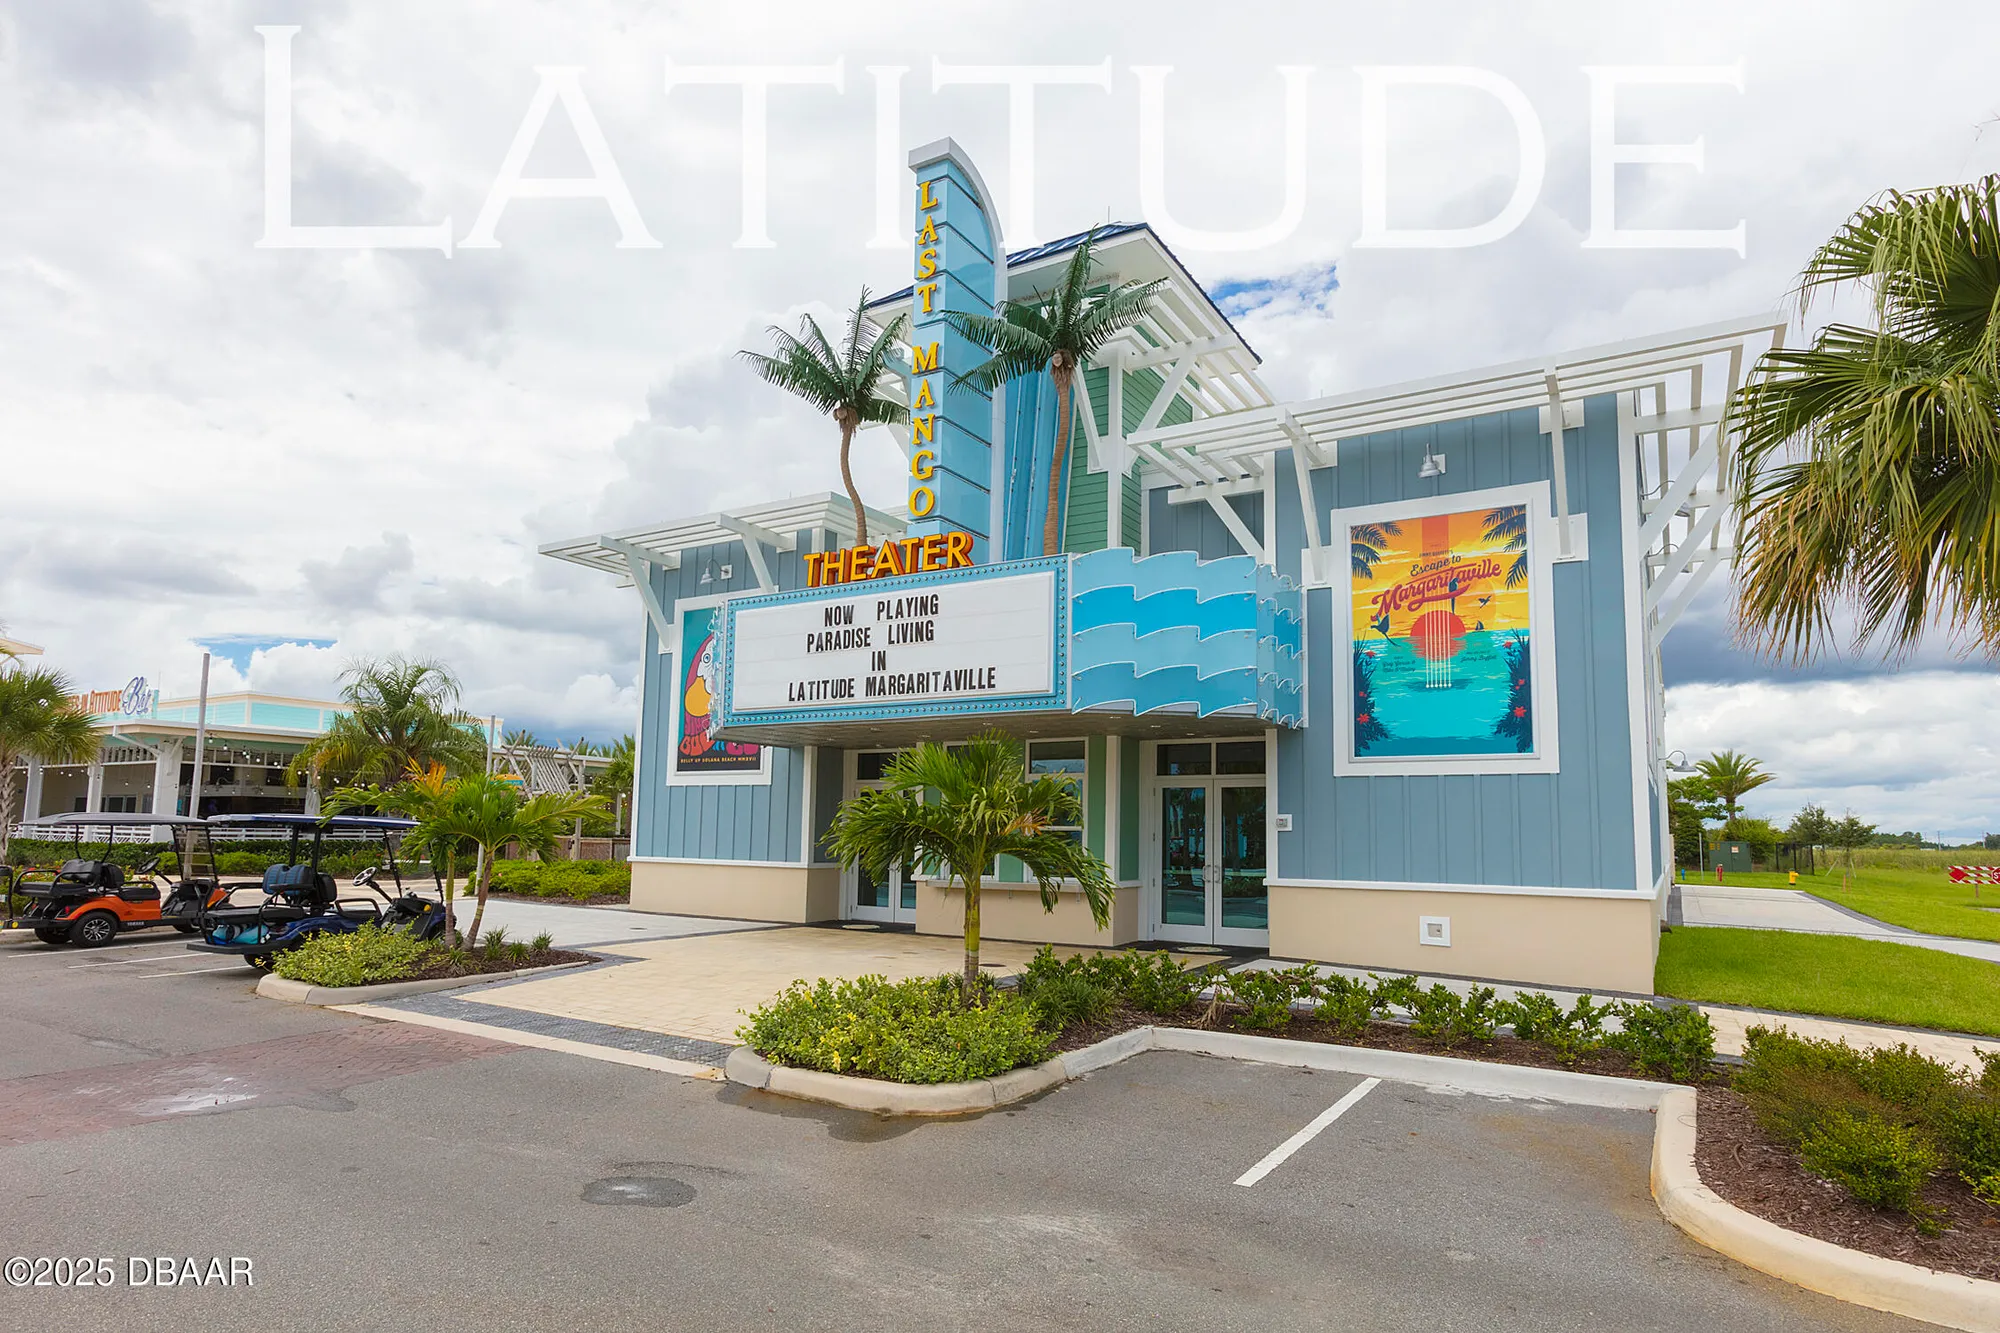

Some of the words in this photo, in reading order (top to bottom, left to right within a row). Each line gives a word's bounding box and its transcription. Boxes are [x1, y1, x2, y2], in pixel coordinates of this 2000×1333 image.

[917, 180, 940, 315] LAST
[908, 341, 940, 519] MANGO
[803, 531, 975, 588] THEATER
[1410, 556, 1451, 577] Escape
[1451, 554, 1462, 564] to
[1371, 558, 1502, 621] Margaritaville
[824, 604, 855, 628] NOW
[876, 593, 940, 622] PLAYING
[806, 626, 871, 653] PARADISE
[887, 619, 935, 646] LIVING
[871, 650, 887, 672] IN
[122, 676, 152, 716] Bar
[788, 677, 855, 702] LATITUDE
[864, 666, 997, 698] MARGARITAVILLE
